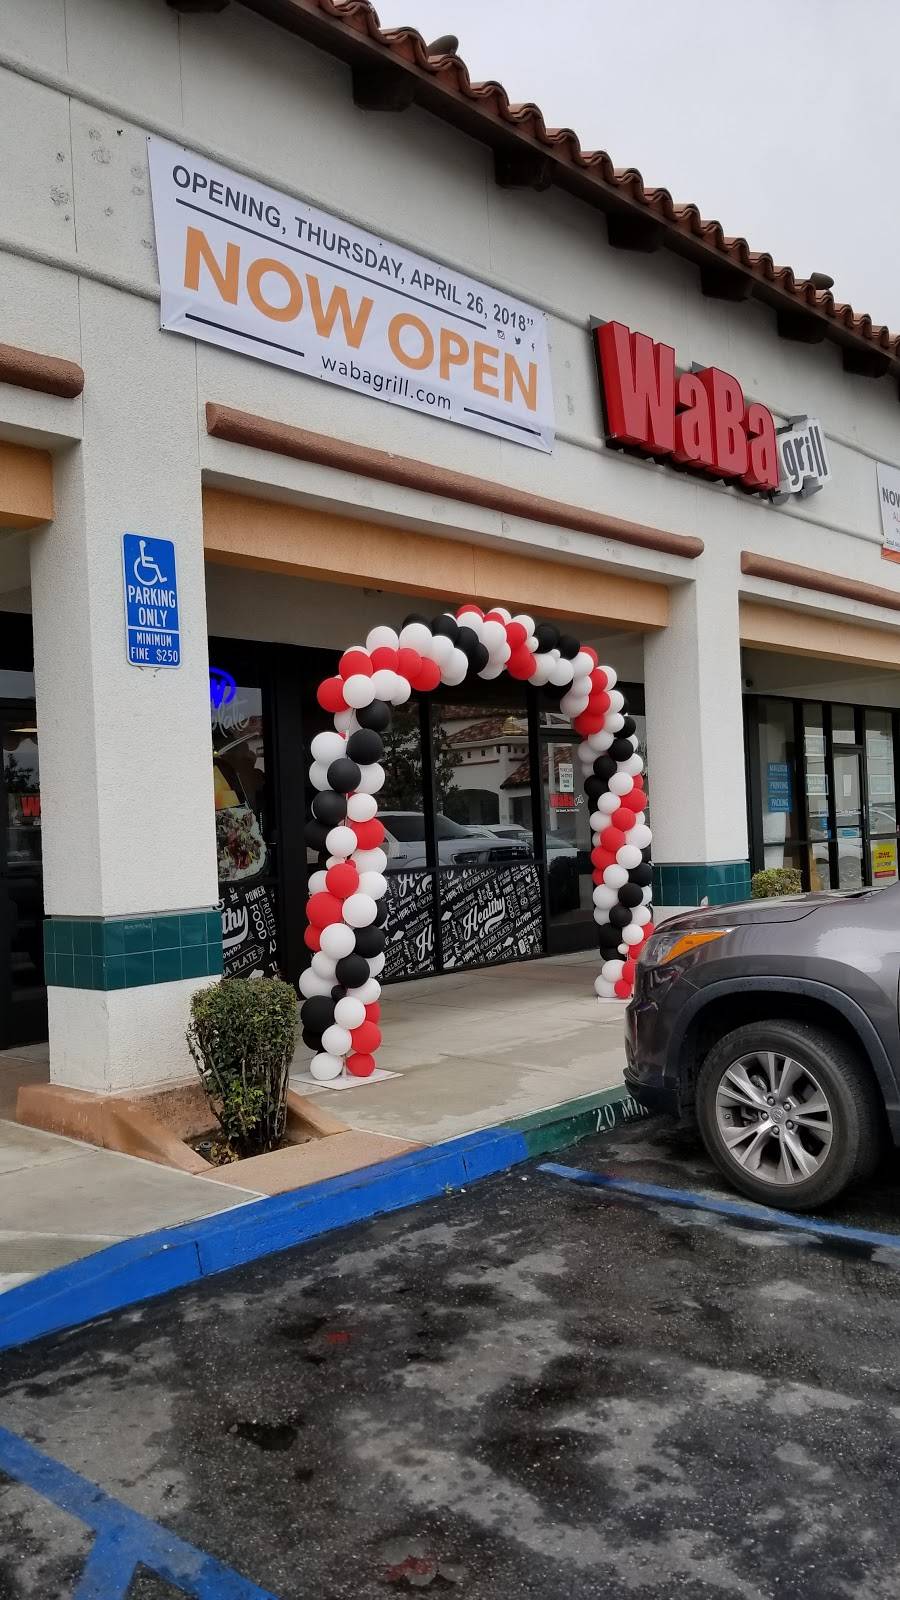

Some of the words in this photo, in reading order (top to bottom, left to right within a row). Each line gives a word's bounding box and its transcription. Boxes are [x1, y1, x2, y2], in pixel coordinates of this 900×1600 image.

[172, 164, 287, 234] OPENING,
[294, 216, 405, 286] THURSDAY,
[410, 269, 462, 305] APRIL
[466, 292, 488, 319] 26,
[184, 226, 374, 349] NOW
[388, 312, 538, 412] OPEN
[321, 355, 452, 411] wabagrill.com
[596, 320, 779, 492] WaBa
[782, 424, 828, 486] grill
[128, 585, 176, 609] PARKING
[138, 607, 168, 628] ONLY
[136, 632, 172, 648] MINIMUM
[131, 646, 150, 661] FINE
[156, 648, 179, 663] $250
[245, 885, 266, 903] POWER
[506, 895, 515, 919] FOOD
[250, 903, 267, 940] FOOD
[463, 897, 506, 941] Healthy
[232, 949, 258, 972] PLATE
[592, 1103, 616, 1133] 20
